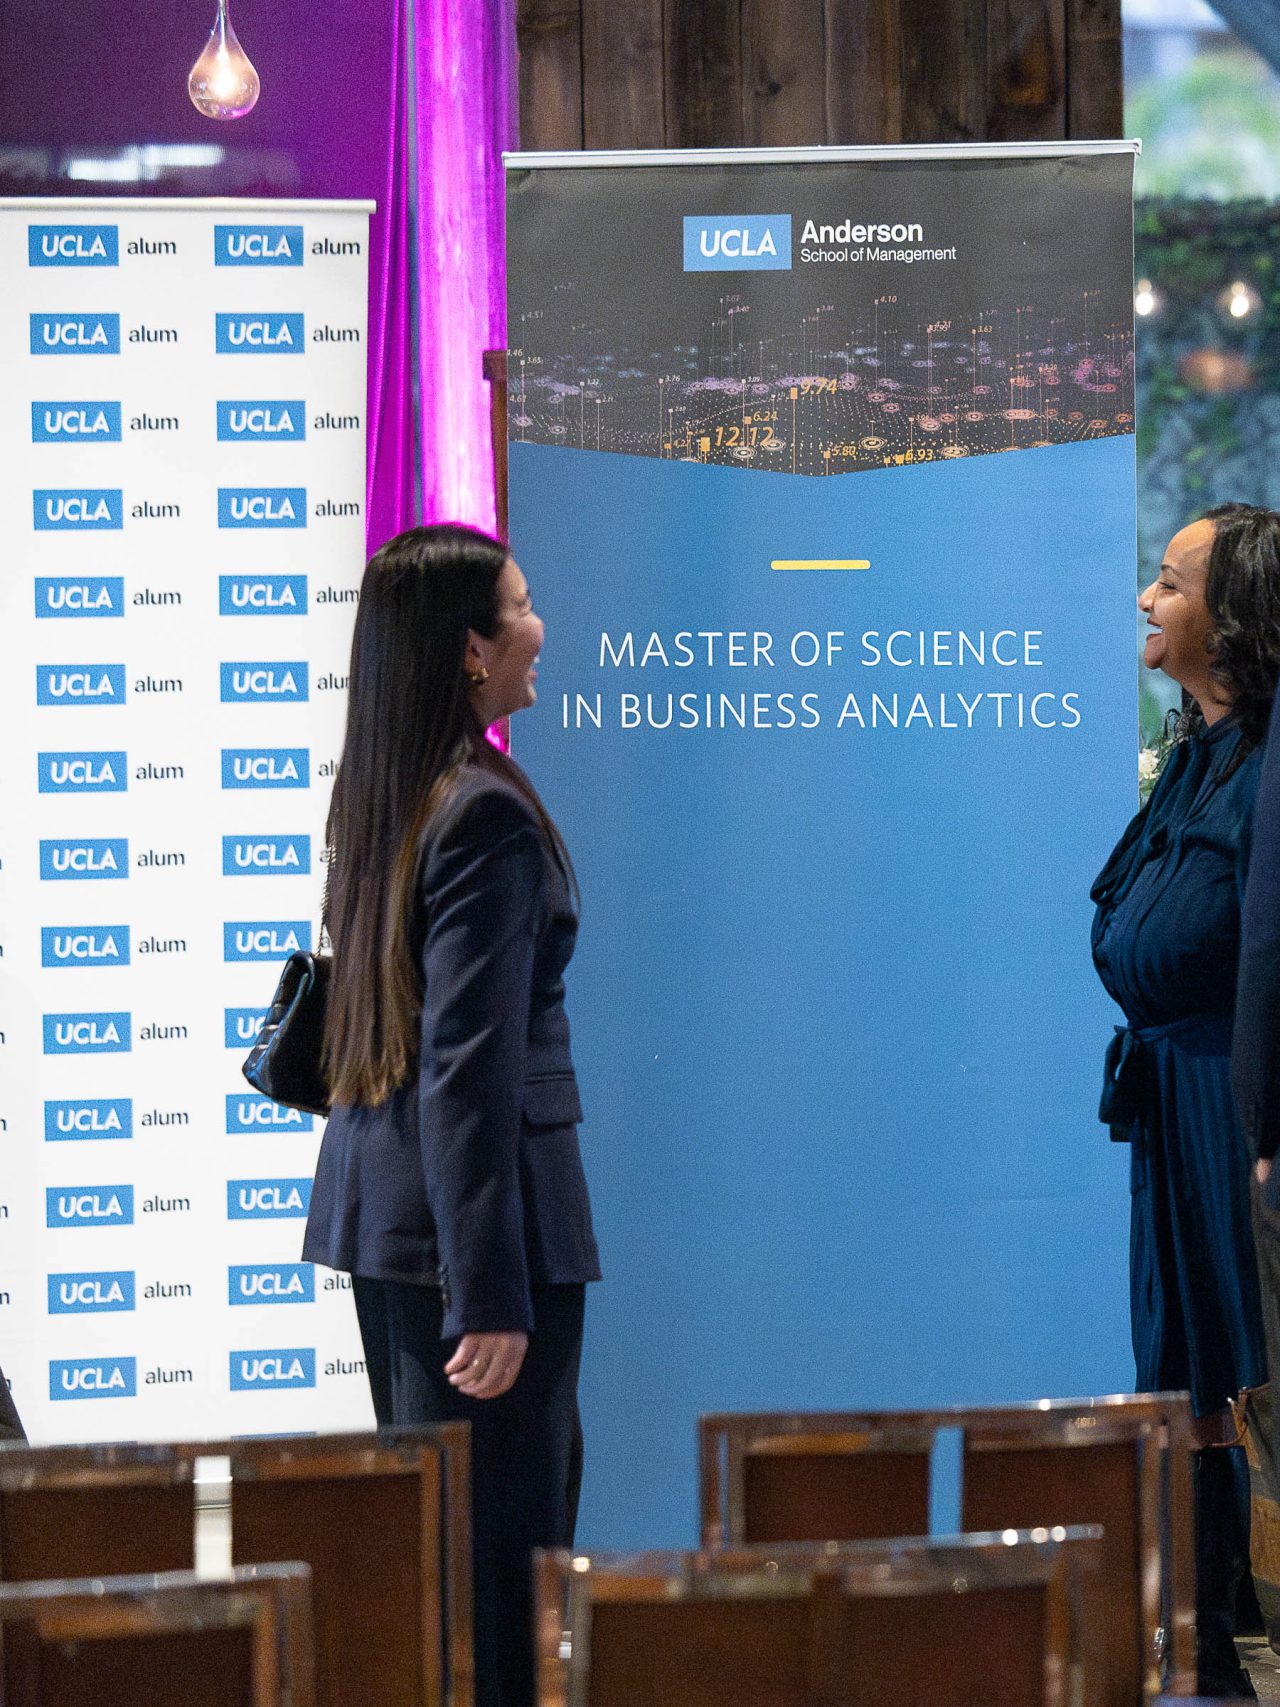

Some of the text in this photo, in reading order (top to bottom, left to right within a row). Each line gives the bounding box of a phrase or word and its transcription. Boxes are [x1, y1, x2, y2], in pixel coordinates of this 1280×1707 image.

[700, 229, 777, 258] UCLA
[800, 219, 923, 244] Anderson
[41, 234, 177, 257] UCLA alum
[227, 234, 361, 258] UCLA alum
[800, 246, 957, 264] School of Management
[43, 322, 178, 346] UCLA alum
[228, 321, 360, 346] UCLA alum
[800, 379, 838, 396] 9.74
[44, 410, 179, 434] UCLA alum
[229, 409, 360, 433] UCLA alum
[753, 411, 778, 422] 6.24
[715, 426, 773, 447] 12.12
[832, 445, 856, 457] 5.80
[905, 448, 933, 461] 6.93
[46, 497, 180, 522] UCLA alum
[230, 496, 360, 520] UCLA alum
[47, 585, 182, 609] UCLA alum
[231, 583, 359, 607] UCLA alum
[599, 630, 1043, 667] MASTER OF SCIENCE
[48, 673, 183, 697] UCLA alum
[232, 670, 349, 694] UCLA alu
[562, 692, 1082, 729] IN BUSINESS ANALYTICS
[50, 759, 184, 785] UCLA alum
[233, 756, 299, 781] UCLA
[52, 847, 185, 872] UCLA alum
[234, 843, 300, 867] UCLA
[53, 934, 187, 959] UCLA alum
[235, 929, 301, 953] UCLA
[54, 1021, 188, 1045] UCLA alum
[56, 1107, 189, 1132] UCLA alum
[237, 1101, 304, 1126] UCLA
[58, 1194, 190, 1219] UCLA alum
[238, 1187, 305, 1211] UCLA
[59, 1280, 191, 1306] UCLA alum
[239, 1272, 352, 1297] UCLA alu
[61, 1366, 193, 1392] UCLA alum
[240, 1357, 307, 1382] UCLA
